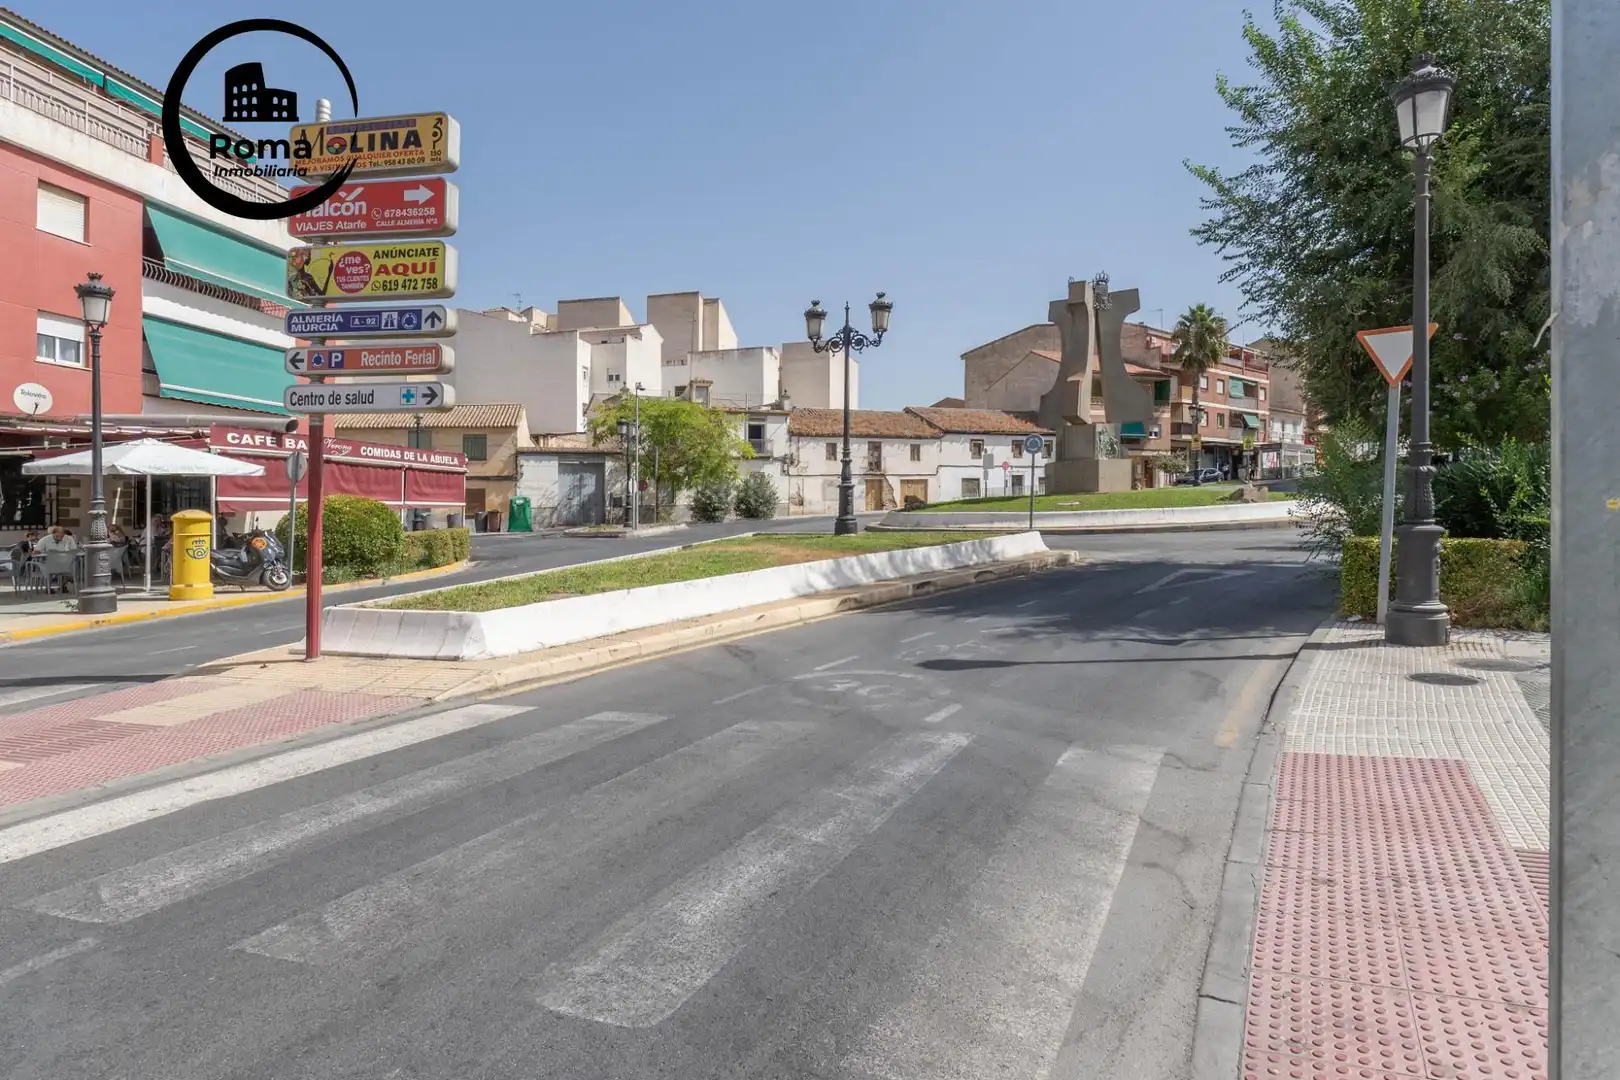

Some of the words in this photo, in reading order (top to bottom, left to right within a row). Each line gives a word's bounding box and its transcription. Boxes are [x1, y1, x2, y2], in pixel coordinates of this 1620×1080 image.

[295, 156, 344, 165] MEJORAMOS
[393, 149, 424, 158] OFERTA
[417, 156, 426, 164] 09
[296, 187, 367, 218] alcón
[384, 207, 435, 218] 678436258
[296, 221, 333, 232] VIAJES
[336, 219, 367, 230] Atarfe
[376, 219, 396, 227] CALLE
[373, 246, 439, 259] ANÚNCIATE
[338, 256, 361, 268] ¿me
[346, 263, 371, 274] ves?
[374, 258, 437, 277] AQUÍ
[382, 279, 399, 292] 619
[401, 278, 418, 291] 472
[421, 277, 438, 290] 758
[291, 313, 344, 324] ALMERÍA
[291, 323, 339, 333] MURCIA
[331, 352, 342, 367] P
[361, 350, 401, 367] Recinto
[405, 349, 436, 365] Ferial
[290, 391, 325, 407] Centro
[328, 390, 342, 405] de
[345, 389, 375, 405] salud
[226, 432, 277, 448] CAFE
[284, 438, 308, 450] BA
[360, 446, 402, 459] COMIDAS
[404, 451, 415, 461] DE
[417, 452, 428, 462] LA
[430, 454, 459, 465] ABUELA
